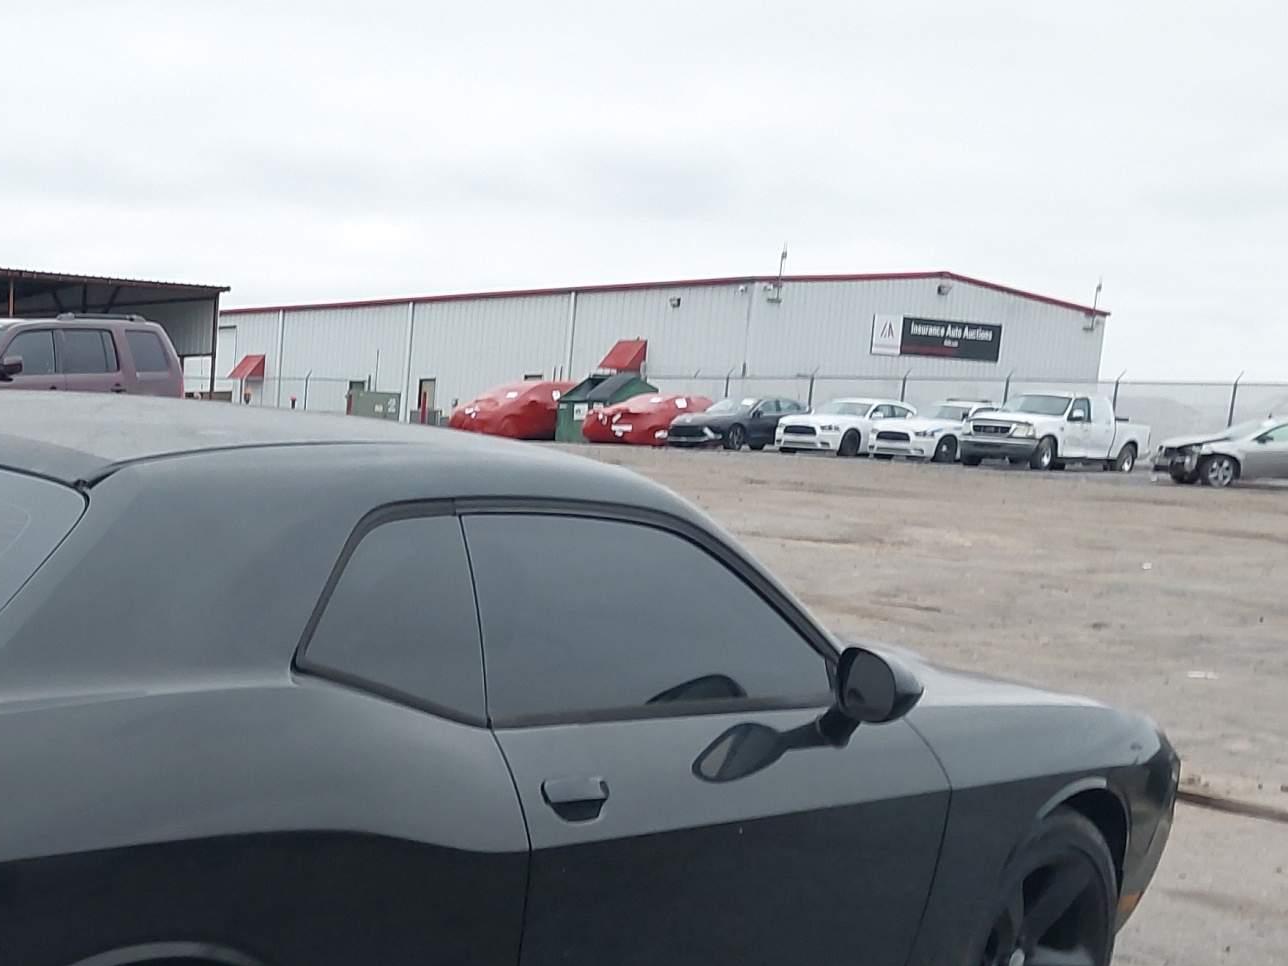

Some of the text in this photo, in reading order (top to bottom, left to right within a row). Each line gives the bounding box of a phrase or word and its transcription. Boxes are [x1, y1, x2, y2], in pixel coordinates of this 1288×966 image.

[910, 320, 993, 342] Insurance Auto Auctions
